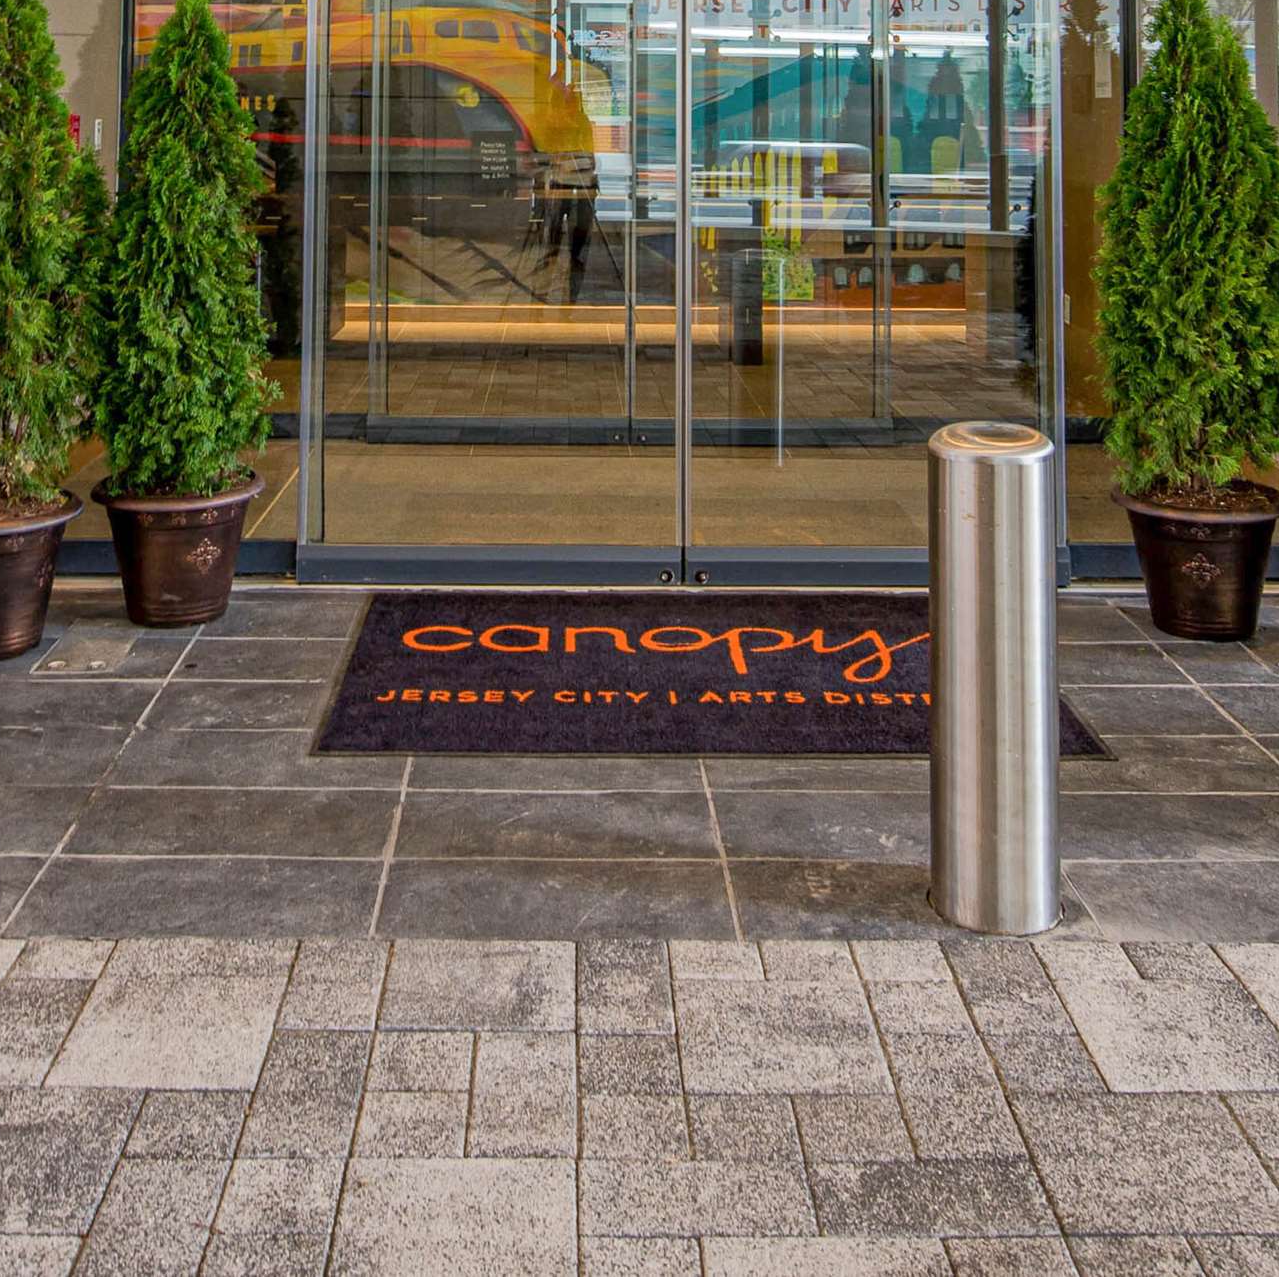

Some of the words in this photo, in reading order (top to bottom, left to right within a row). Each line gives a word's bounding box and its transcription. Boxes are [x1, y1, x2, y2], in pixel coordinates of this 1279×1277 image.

[402, 624, 930, 683] canopy
[376, 689, 536, 704] JERSEY
[554, 690, 648, 704] CITY
[698, 690, 807, 705] ARTS
[823, 691, 932, 706] DIST
